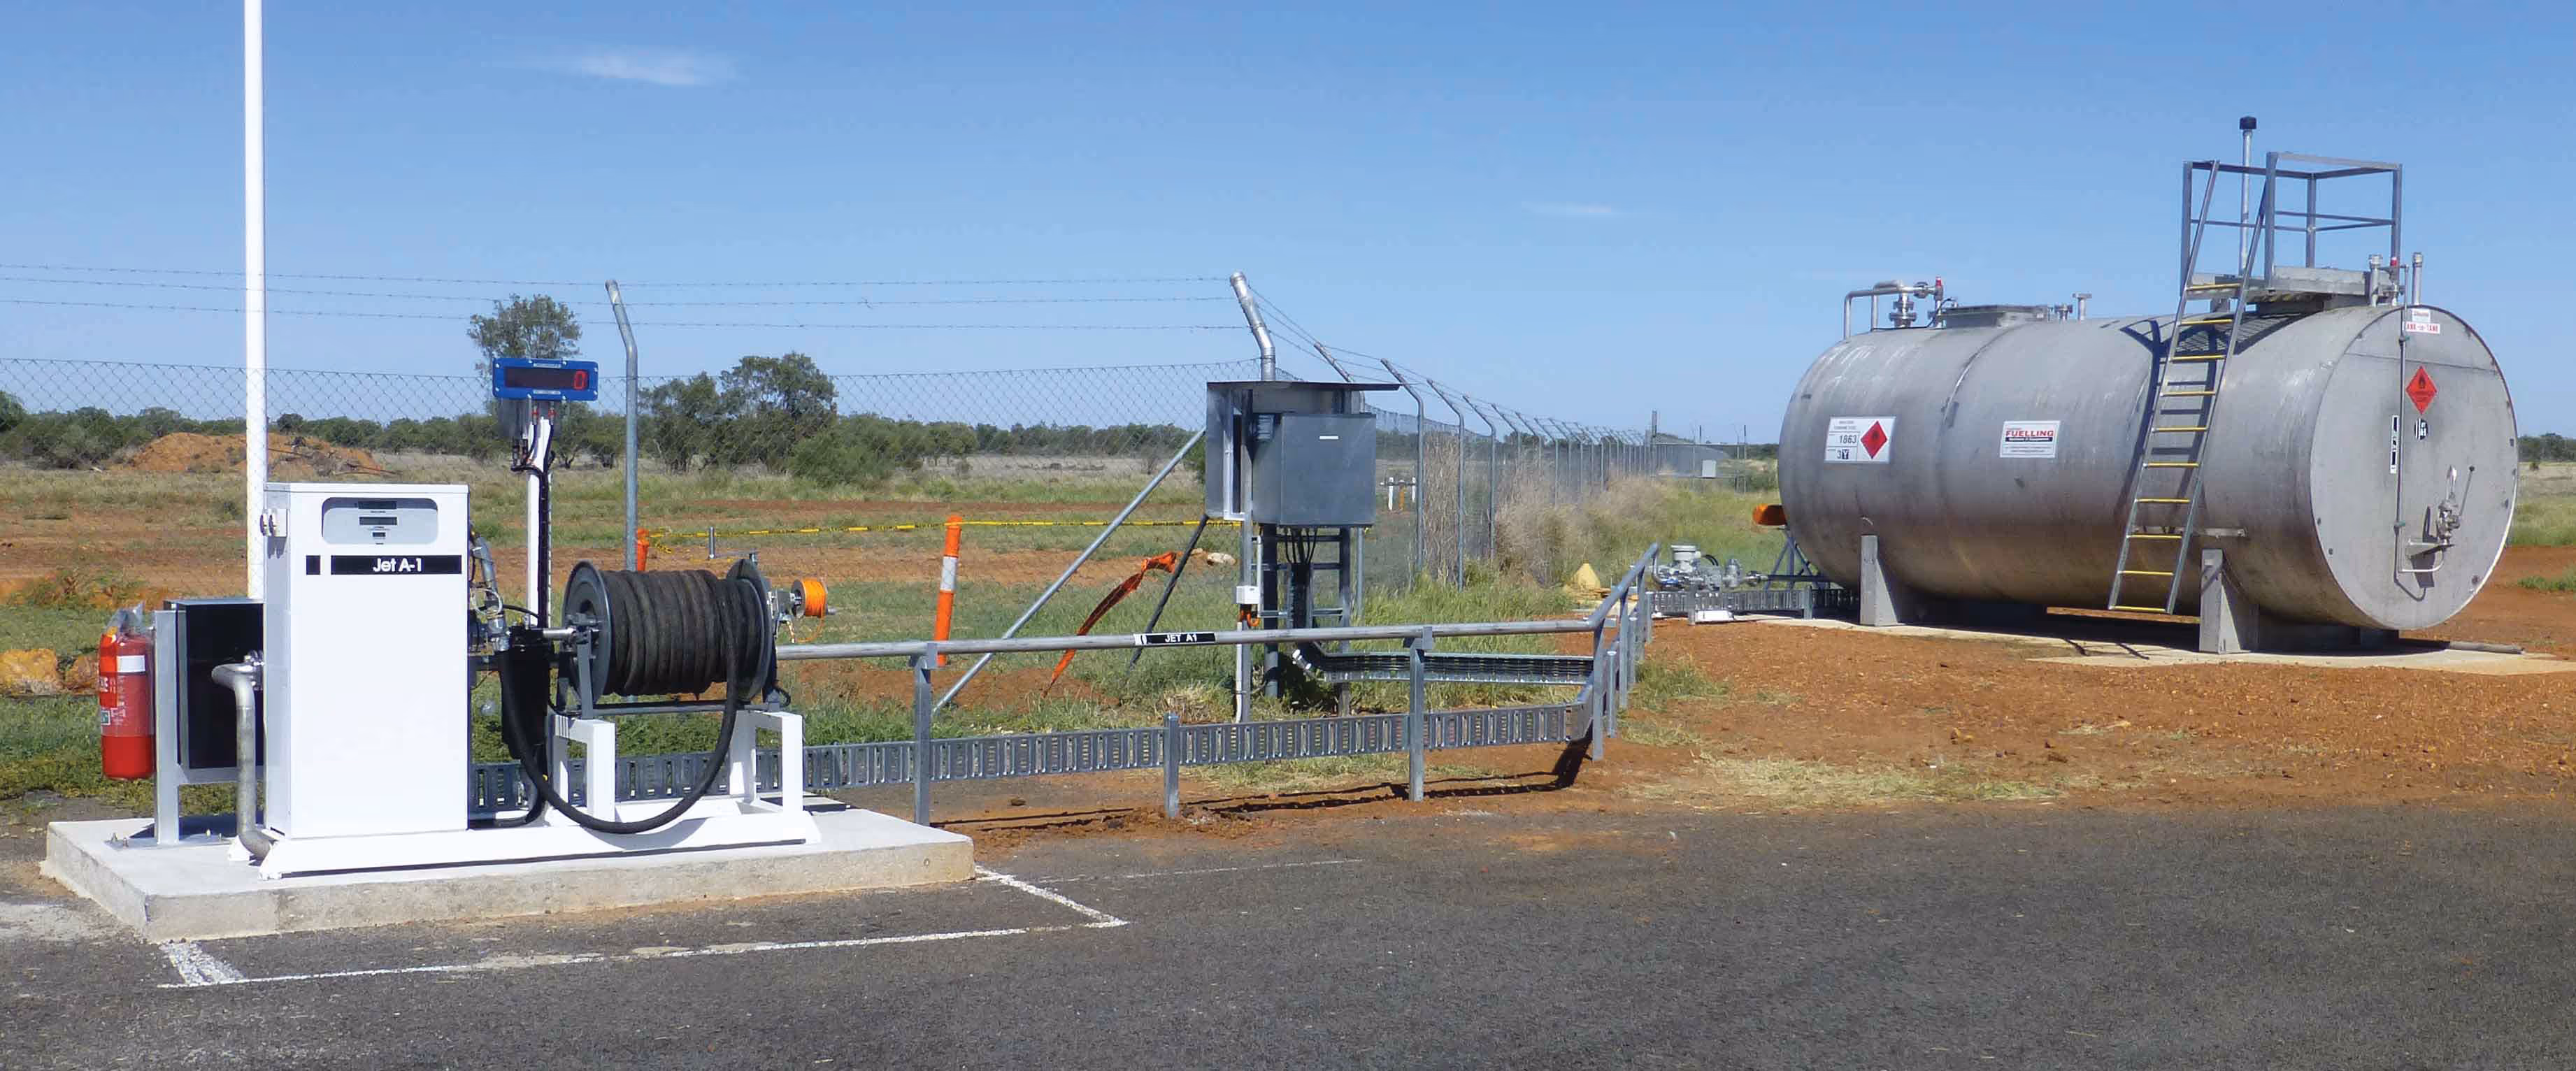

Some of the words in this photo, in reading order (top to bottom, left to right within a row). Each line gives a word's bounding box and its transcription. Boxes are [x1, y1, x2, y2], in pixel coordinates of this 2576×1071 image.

[573, 370, 588, 391] 0
[1839, 434, 1857, 444] 1863
[373, 558, 396, 572] Jet
[399, 558, 422, 572] A-1
[1164, 633, 1182, 642] JET
[1186, 633, 1198, 642] A1
